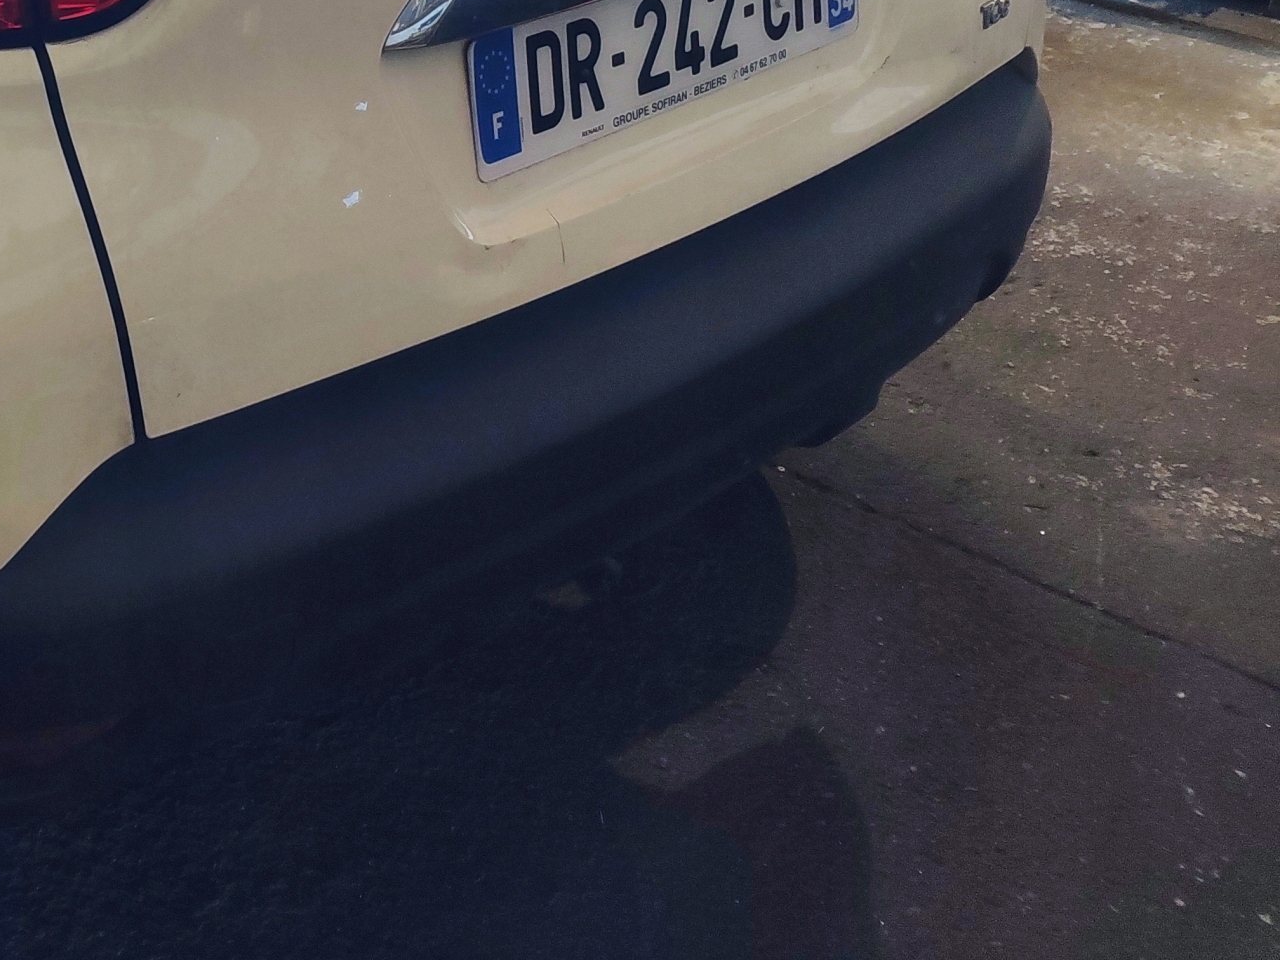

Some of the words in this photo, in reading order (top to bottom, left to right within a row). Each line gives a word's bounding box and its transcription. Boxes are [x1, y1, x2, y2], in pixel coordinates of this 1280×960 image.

[612, 106, 650, 128] GROUPE
[651, 92, 688, 113] SOFIRAN
[693, 74, 727, 97] BEZIERS
[740, 65, 749, 77] 04
[749, 61, 758, 73] 67
[759, 57, 768, 68] 62
[769, 52, 778, 64] 70
[778, 48, 787, 61] 00
[492, 110, 504, 140] F
[581, 124, 605, 138] RENAULT
